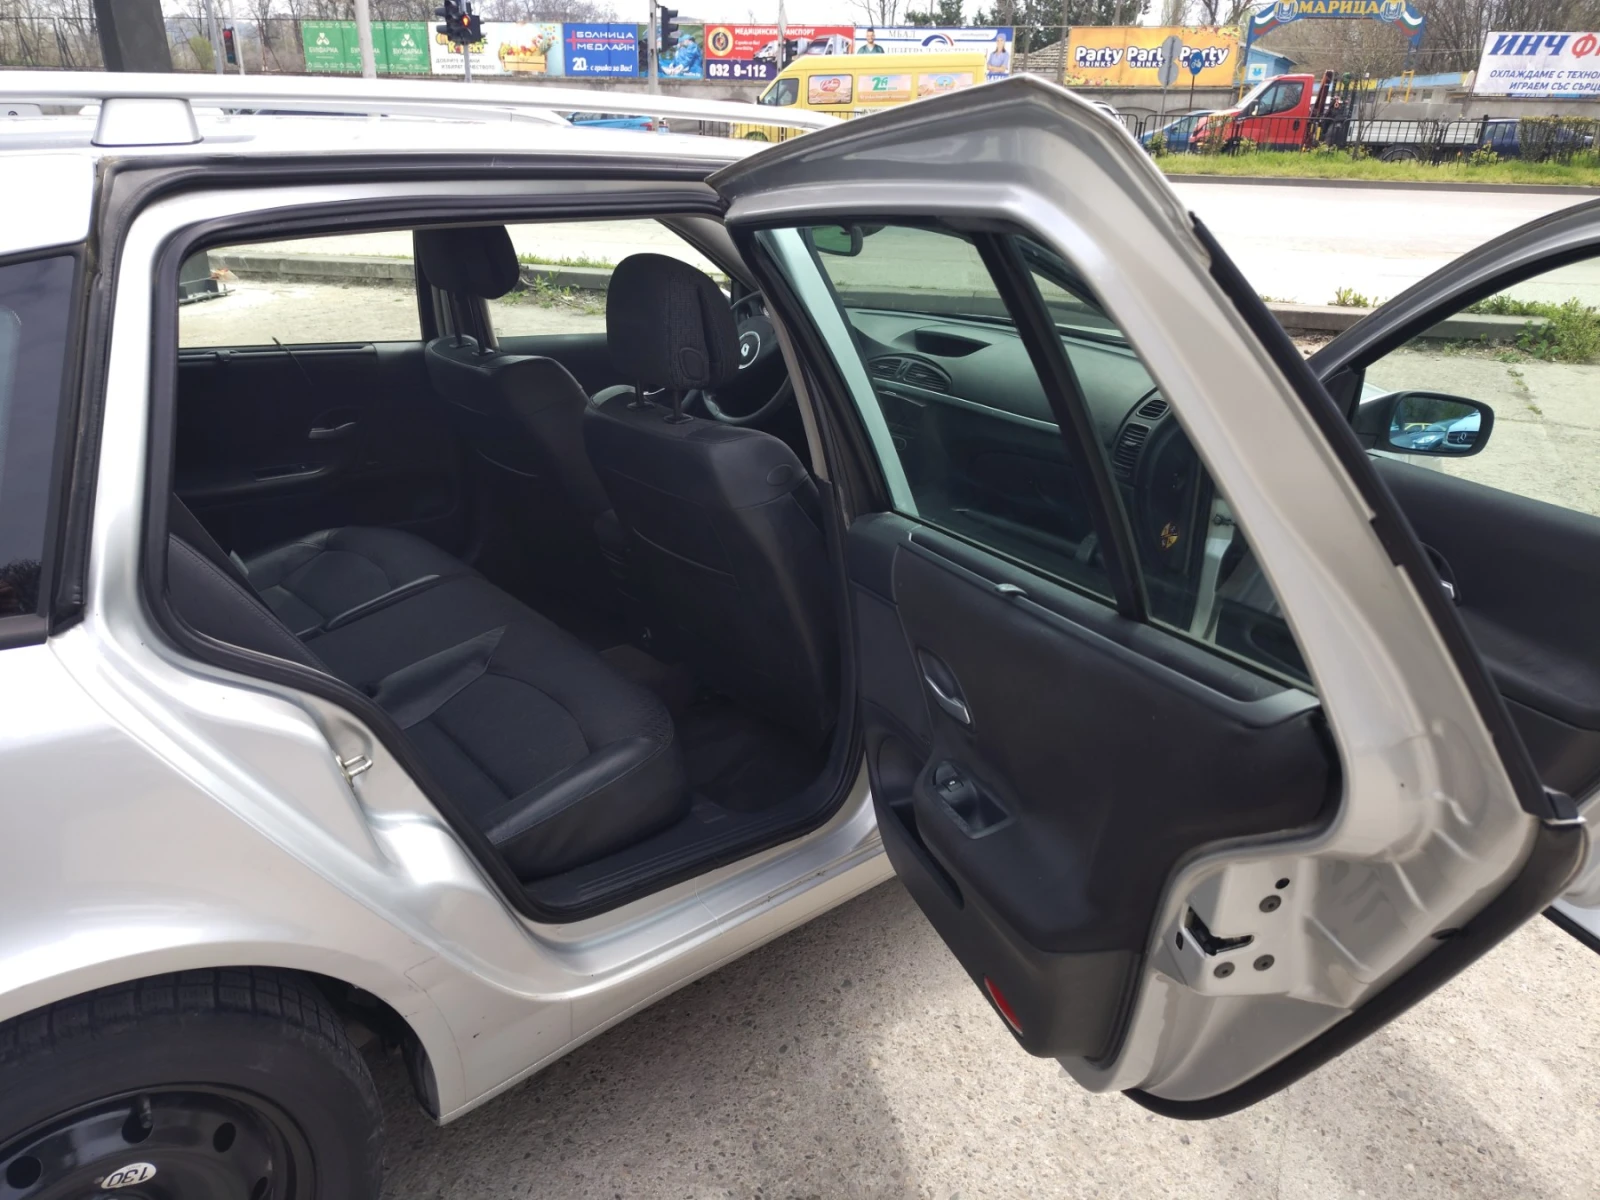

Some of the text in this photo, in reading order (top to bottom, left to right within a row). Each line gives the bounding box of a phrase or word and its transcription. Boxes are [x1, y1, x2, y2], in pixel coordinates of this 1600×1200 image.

[1298, 0, 1380, 15] МАРИЦА
[576, 31, 634, 39] БОЛНИЦА
[577, 43, 635, 51] МЕДЛАЙН
[1488, 34, 1571, 56] ИНЧ
[1075, 46, 1124, 65] Party
[709, 63, 730, 77] 032
[733, 64, 767, 78] 9-112
[1489, 69, 1600, 81] ОХЛАЖДАМЕ С ТЕХНО
[1509, 82, 1549, 91] ИГРАЕМ
[1551, 82, 1570, 91] СЪС
